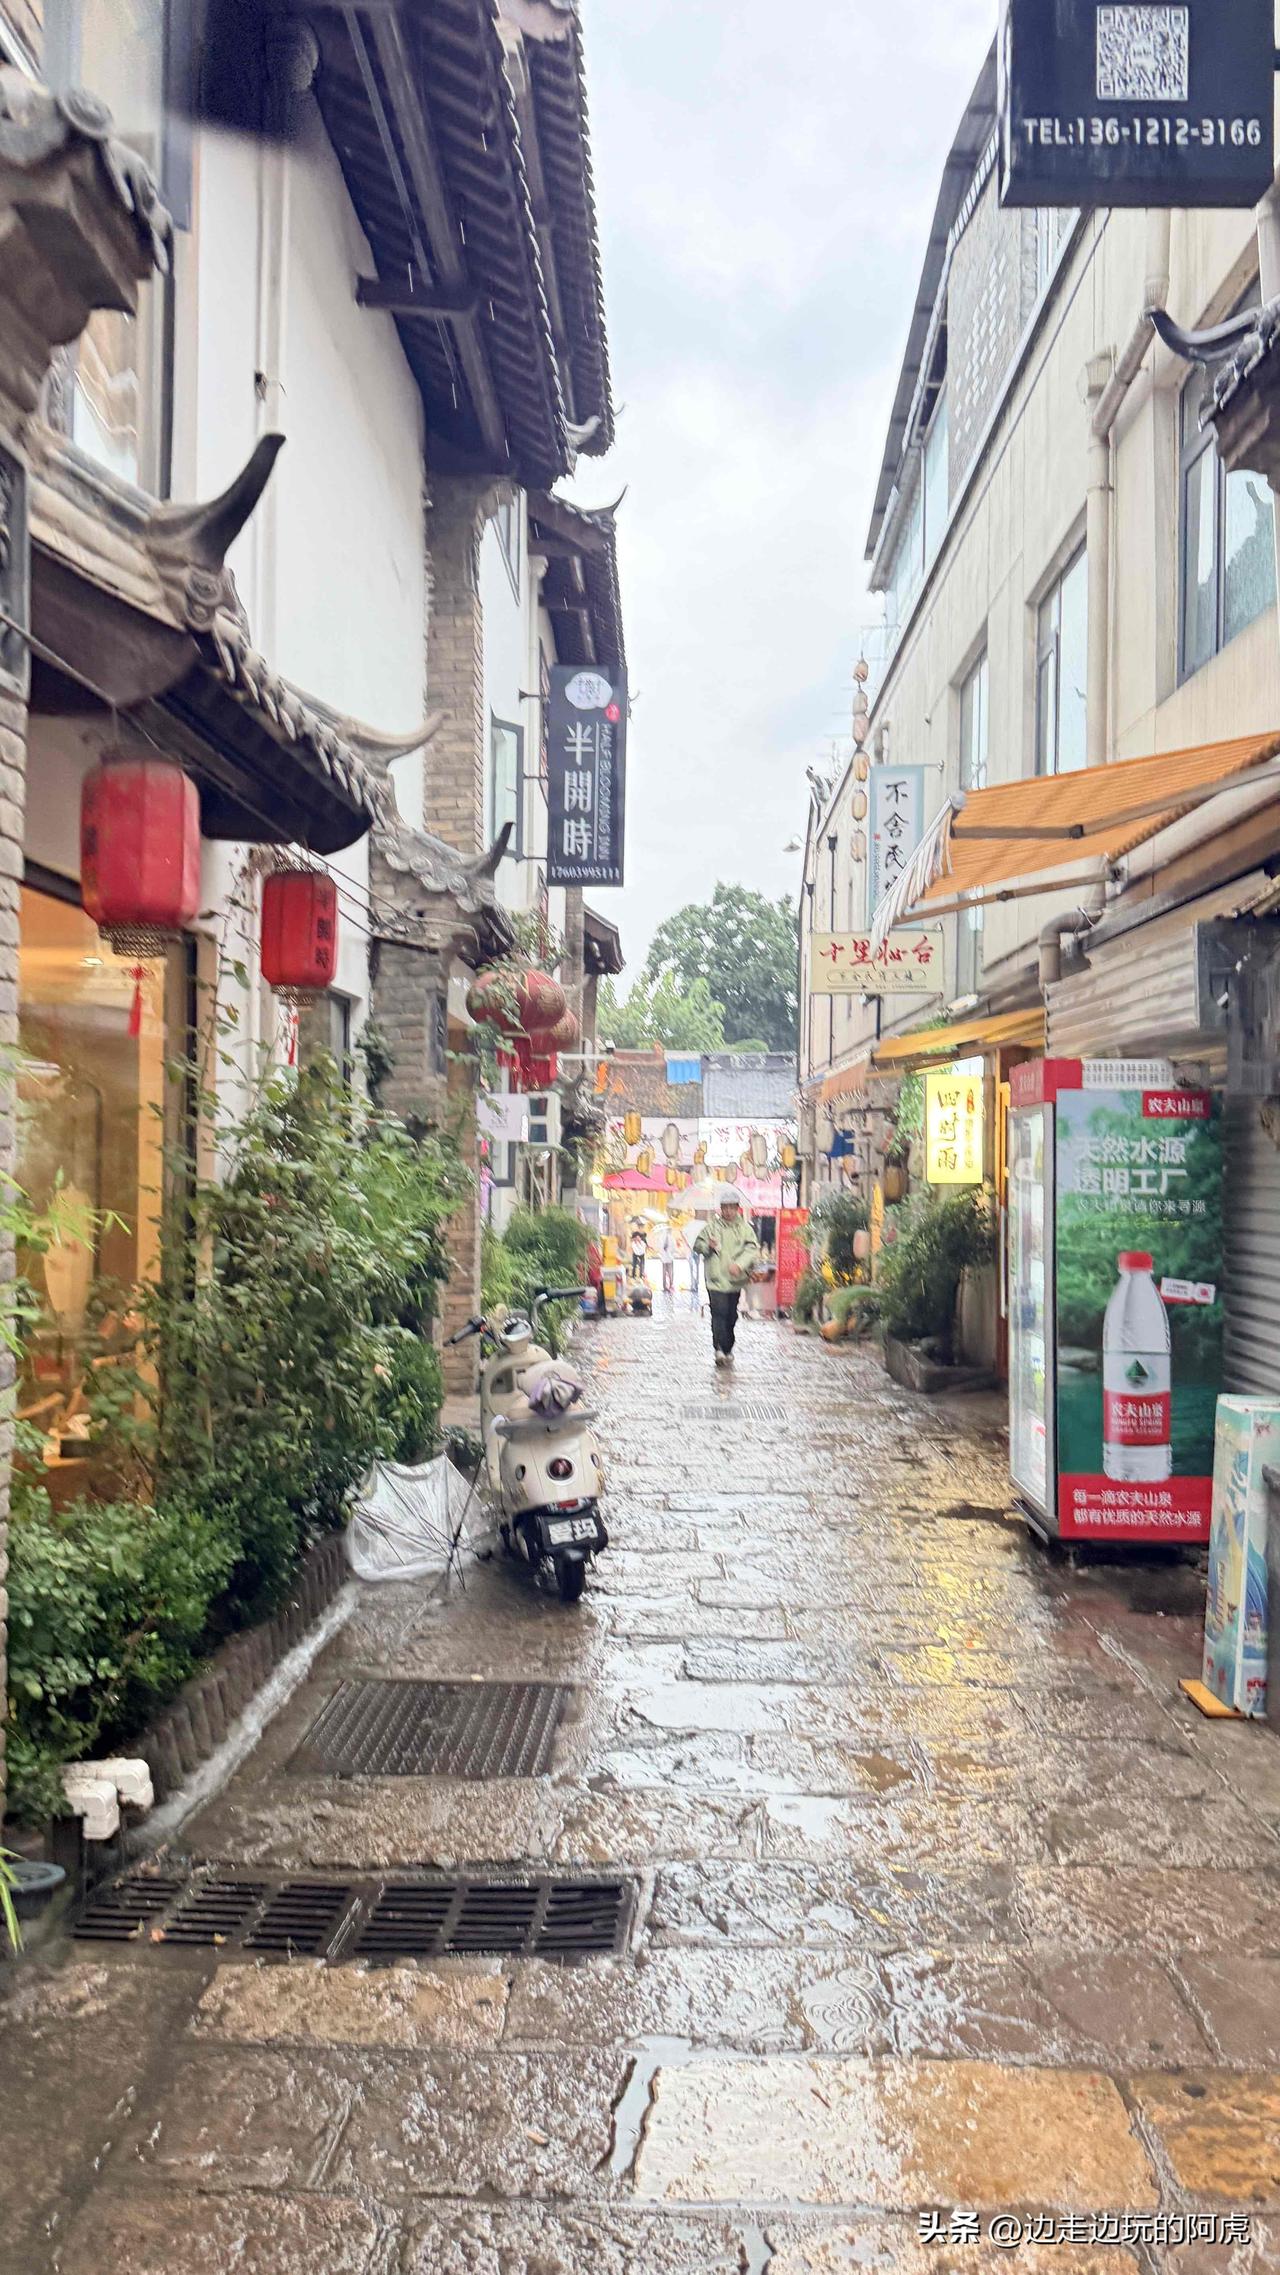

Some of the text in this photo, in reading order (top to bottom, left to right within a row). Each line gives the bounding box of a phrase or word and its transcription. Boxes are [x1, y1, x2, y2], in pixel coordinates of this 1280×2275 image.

[1023, 117, 1262, 146] TEL:136-1212-3166
[562, 721, 595, 862] 半開時
[1147, 1097, 1206, 1115] 农夫山泉
[1070, 1135, 1187, 1164] 天然水源
[1073, 1168, 1188, 1196] 透明工厂
[1111, 1401, 1164, 1418] 农夫山泉
